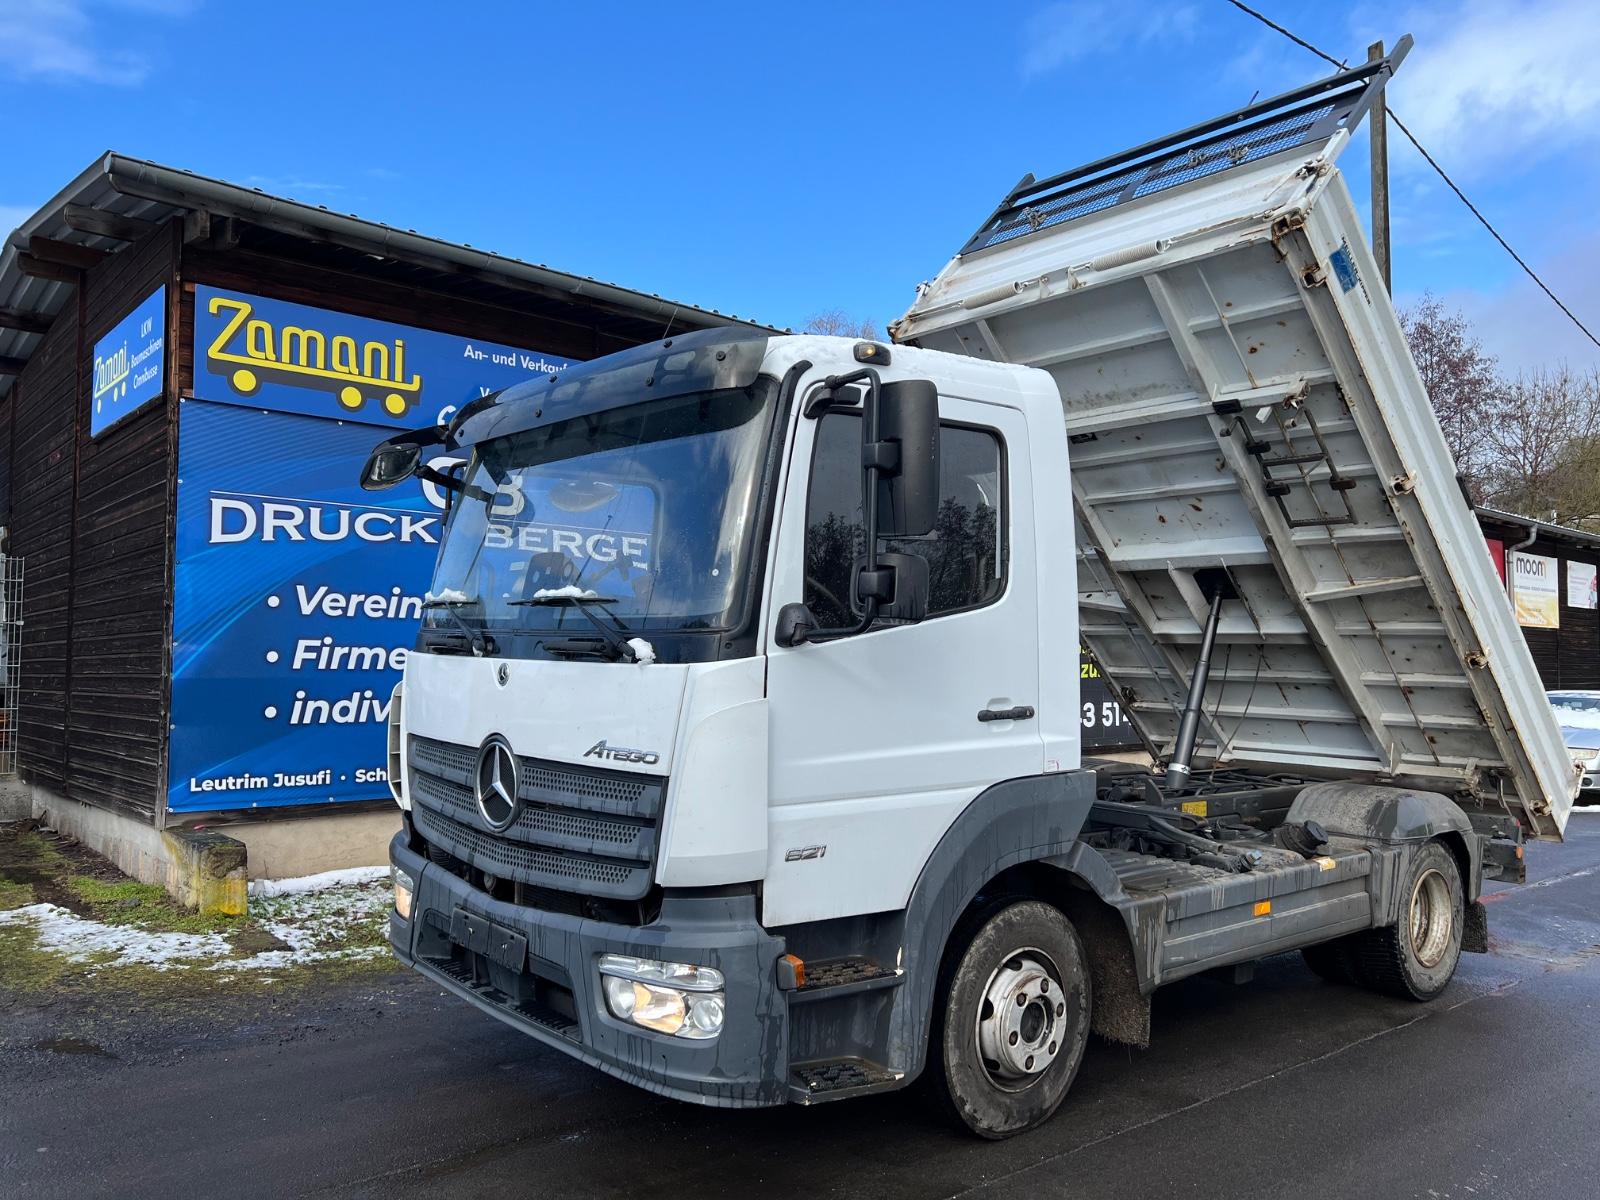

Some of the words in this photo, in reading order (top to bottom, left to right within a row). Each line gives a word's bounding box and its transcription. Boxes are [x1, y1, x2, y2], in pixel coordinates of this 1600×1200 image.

[141, 316, 153, 339] LKW
[131, 336, 163, 369] Baumaschinen
[207, 297, 420, 392] Zamani
[464, 345, 488, 361] An-
[493, 353, 516, 367] und
[94, 339, 130, 399] Zamani
[133, 364, 158, 389] Omnibusse
[209, 498, 439, 544] DRUCK
[296, 585, 422, 619] Verein
[292, 636, 410, 670] Firme
[290, 690, 391, 724] indiv
[1080, 702, 1096, 727] 3
[583, 739, 660, 765] ATEGO
[190, 773, 268, 792] Leutrim
[273, 770, 331, 787] Jusufi
